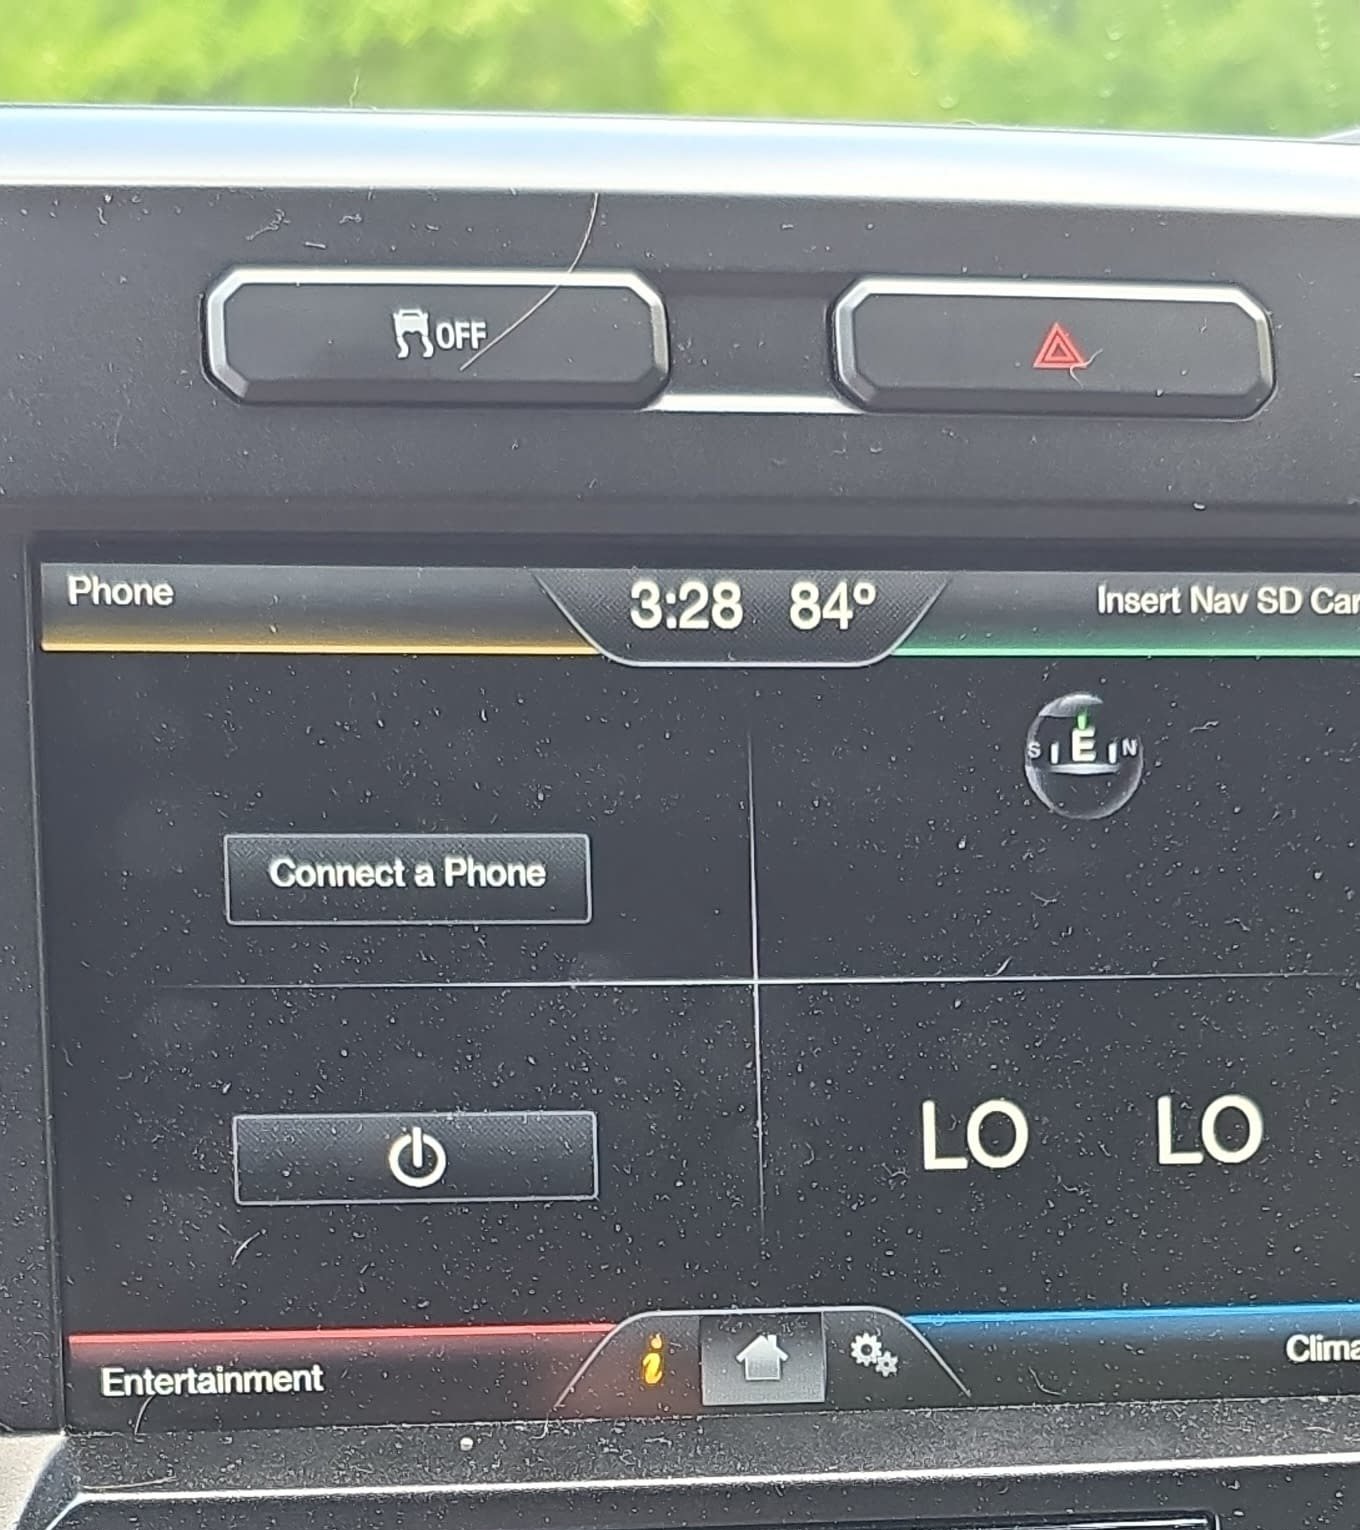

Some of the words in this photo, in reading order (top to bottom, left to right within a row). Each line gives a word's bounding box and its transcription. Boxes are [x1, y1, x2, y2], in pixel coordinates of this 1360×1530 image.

[436, 320, 487, 350] OFF
[68, 574, 174, 606] Phone
[628, 580, 744, 631] 3:28
[1097, 585, 1182, 615] Insert
[1190, 586, 1248, 614] Nav
[1256, 586, 1303, 615] SD
[1028, 741, 1042, 759] S
[1071, 726, 1097, 762] E
[1122, 737, 1138, 757] N
[269, 858, 406, 888] Connect
[415, 866, 436, 888] a
[444, 858, 546, 888] Phone
[922, 1099, 1030, 1170] LO
[1157, 1094, 1264, 1165] LO
[100, 1364, 325, 1398] Entertainment
